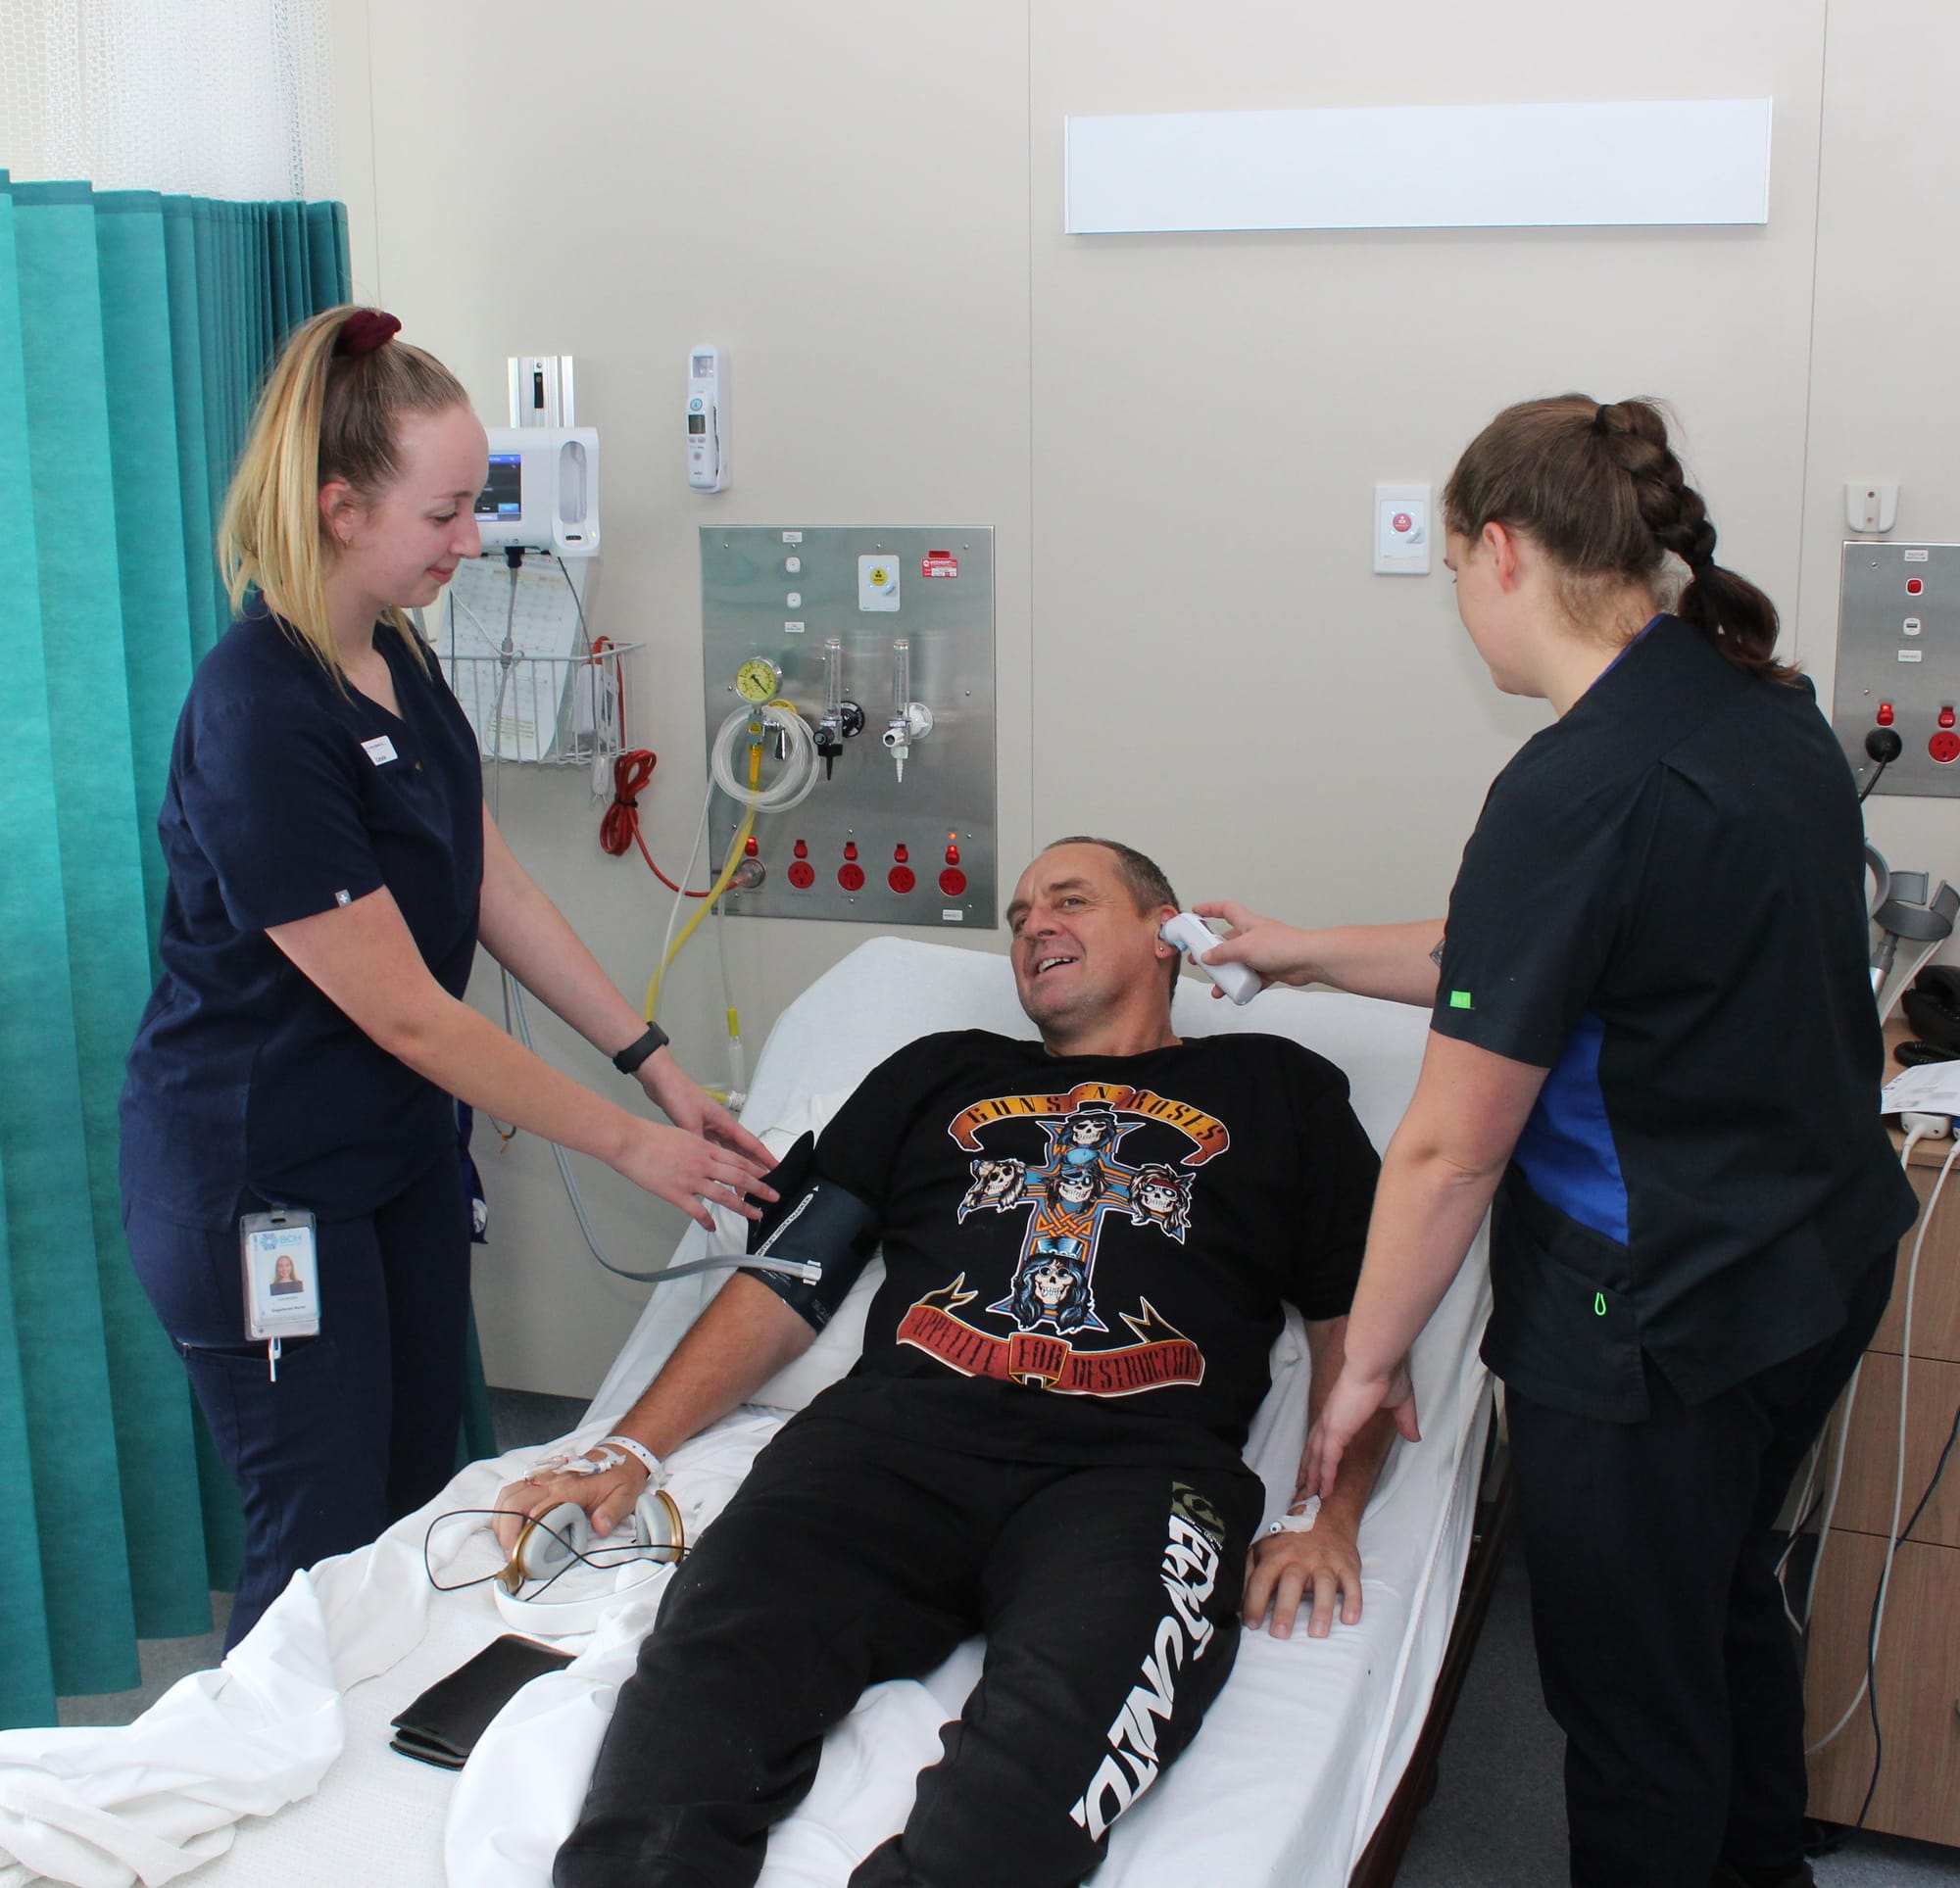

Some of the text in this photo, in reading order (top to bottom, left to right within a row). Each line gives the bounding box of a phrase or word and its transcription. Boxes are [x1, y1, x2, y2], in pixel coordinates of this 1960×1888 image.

[966, 1095, 1061, 1124] GUNS
[1126, 1090, 1225, 1140] ROSES
[910, 1308, 1002, 1372] APPETITE
[1017, 1338, 1064, 1373] FOR
